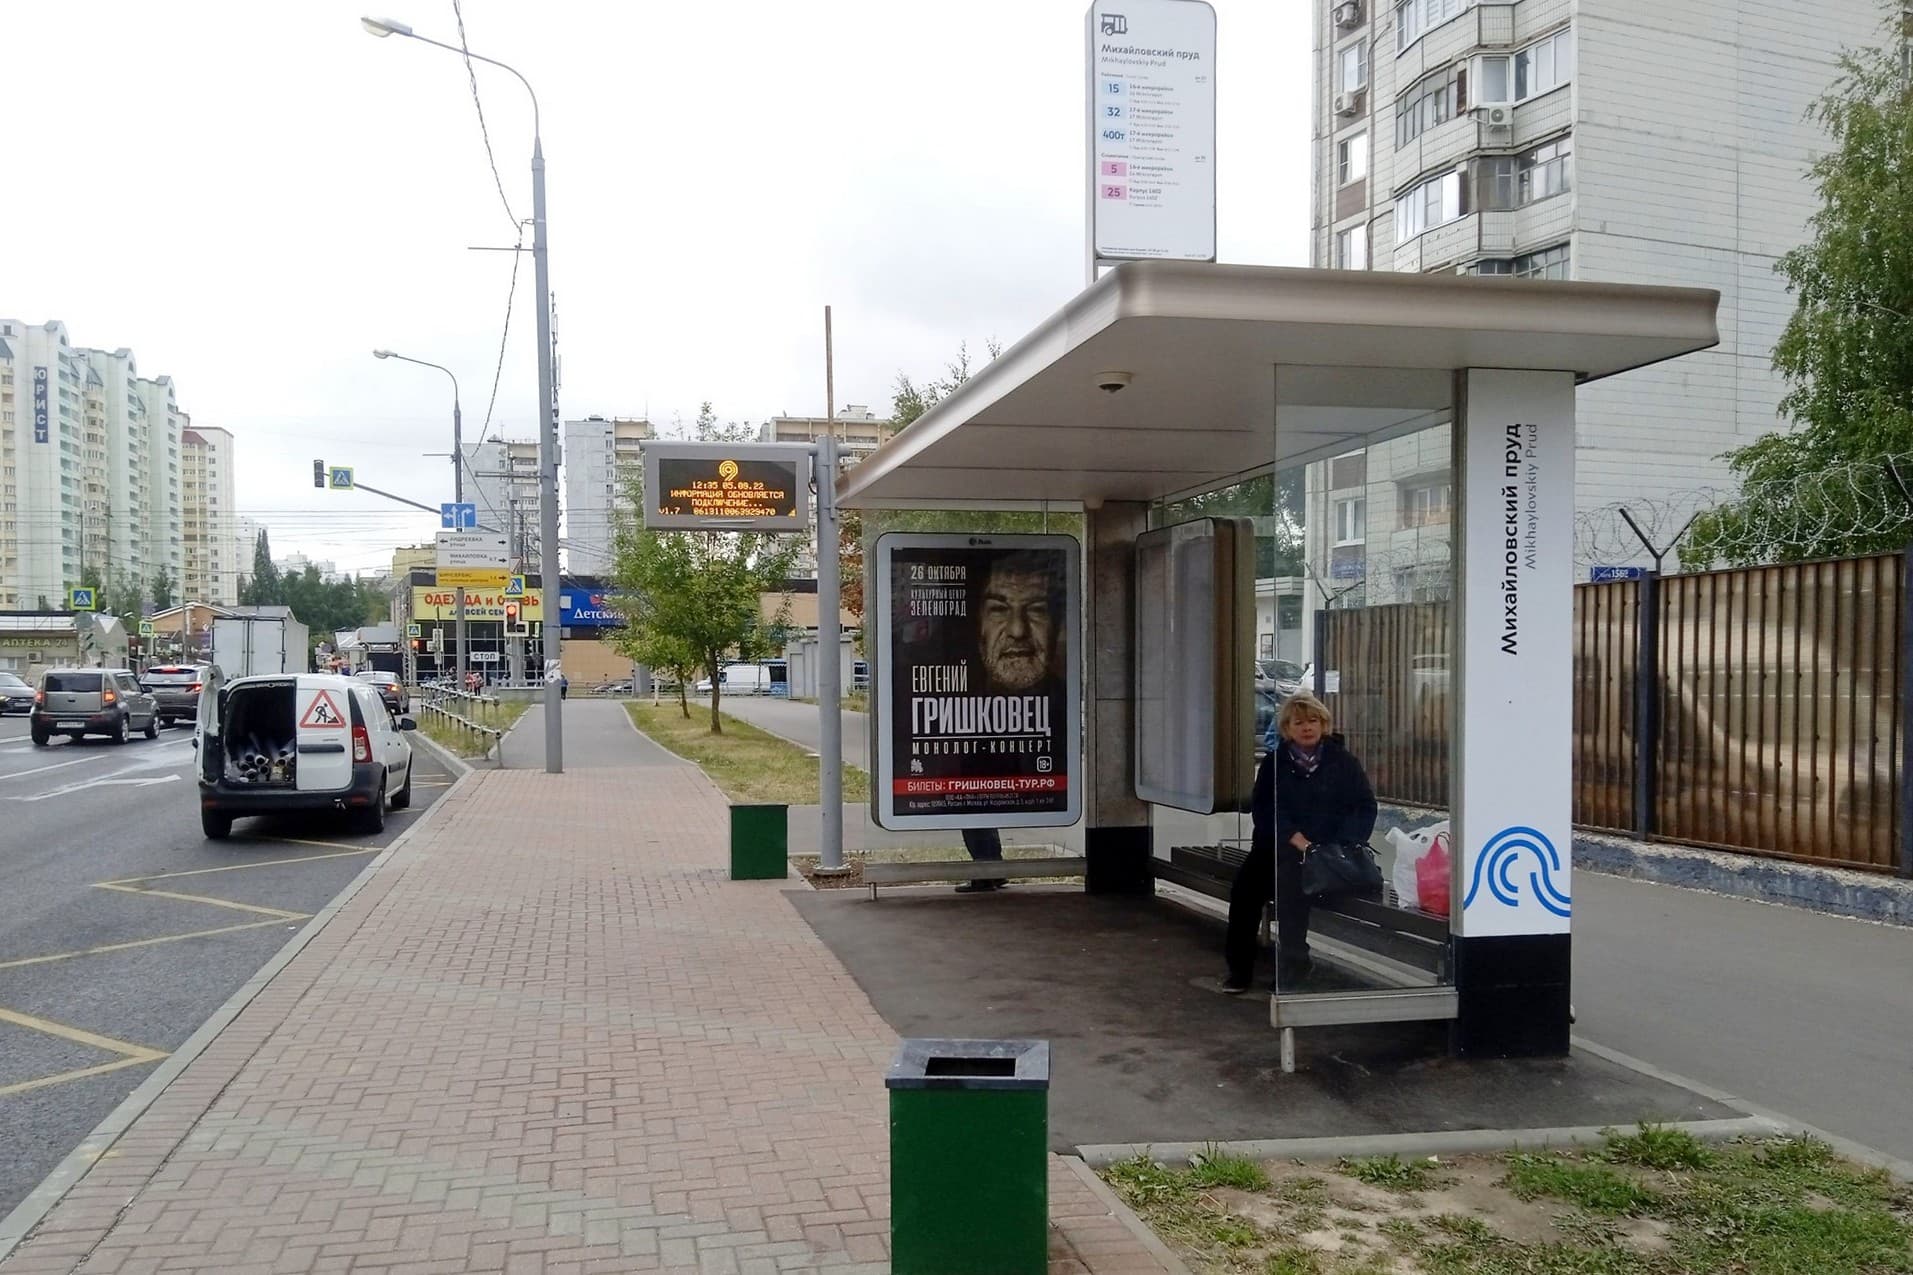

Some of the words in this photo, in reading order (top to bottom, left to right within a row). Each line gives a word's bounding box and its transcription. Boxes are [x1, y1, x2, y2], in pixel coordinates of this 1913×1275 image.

[1101, 44, 1174, 57] Михайловский
[1176, 50, 1200, 60] пруд
[1108, 83, 1120, 94] 15
[1107, 106, 1121, 117] 32
[1103, 130, 1126, 140] 400т
[1111, 164, 1118, 174] 5
[1107, 187, 1121, 197] 25
[1525, 424, 1537, 459] Prud
[1505, 423, 1521, 478] пруд
[670, 490, 724, 498] ИНФОРМАЦИЯ
[727, 491, 784, 499] ОБНОВЛЯЕТСЯ
[1525, 463, 1539, 570] Mikhaylovskiy
[911, 565, 924, 580] 26
[928, 566, 966, 580] ОКТЯБРЯ
[1501, 485, 1518, 656] Михайловский
[911, 587, 947, 600] КУЛЬТУРНЫЙ
[949, 589, 966, 600] ЦЕНТР
[497, 595, 539, 606] ОВЬ
[465, 607, 487, 616] ВСЕЙ
[911, 600, 967, 617] ЗЕЛЕНОГРАД
[2, 639, 51, 648] АПТЕКА
[912, 659, 968, 693] ЕВГЕНИЙ
[912, 696, 1051, 737] ГРИШКОВЕЦ
[1038, 760, 1050, 769] 18+
[907, 781, 946, 792] БИЛЕТЫ:
[948, 779, 1055, 791] ГРИШКОВЕЦ-ТУР.РФ
